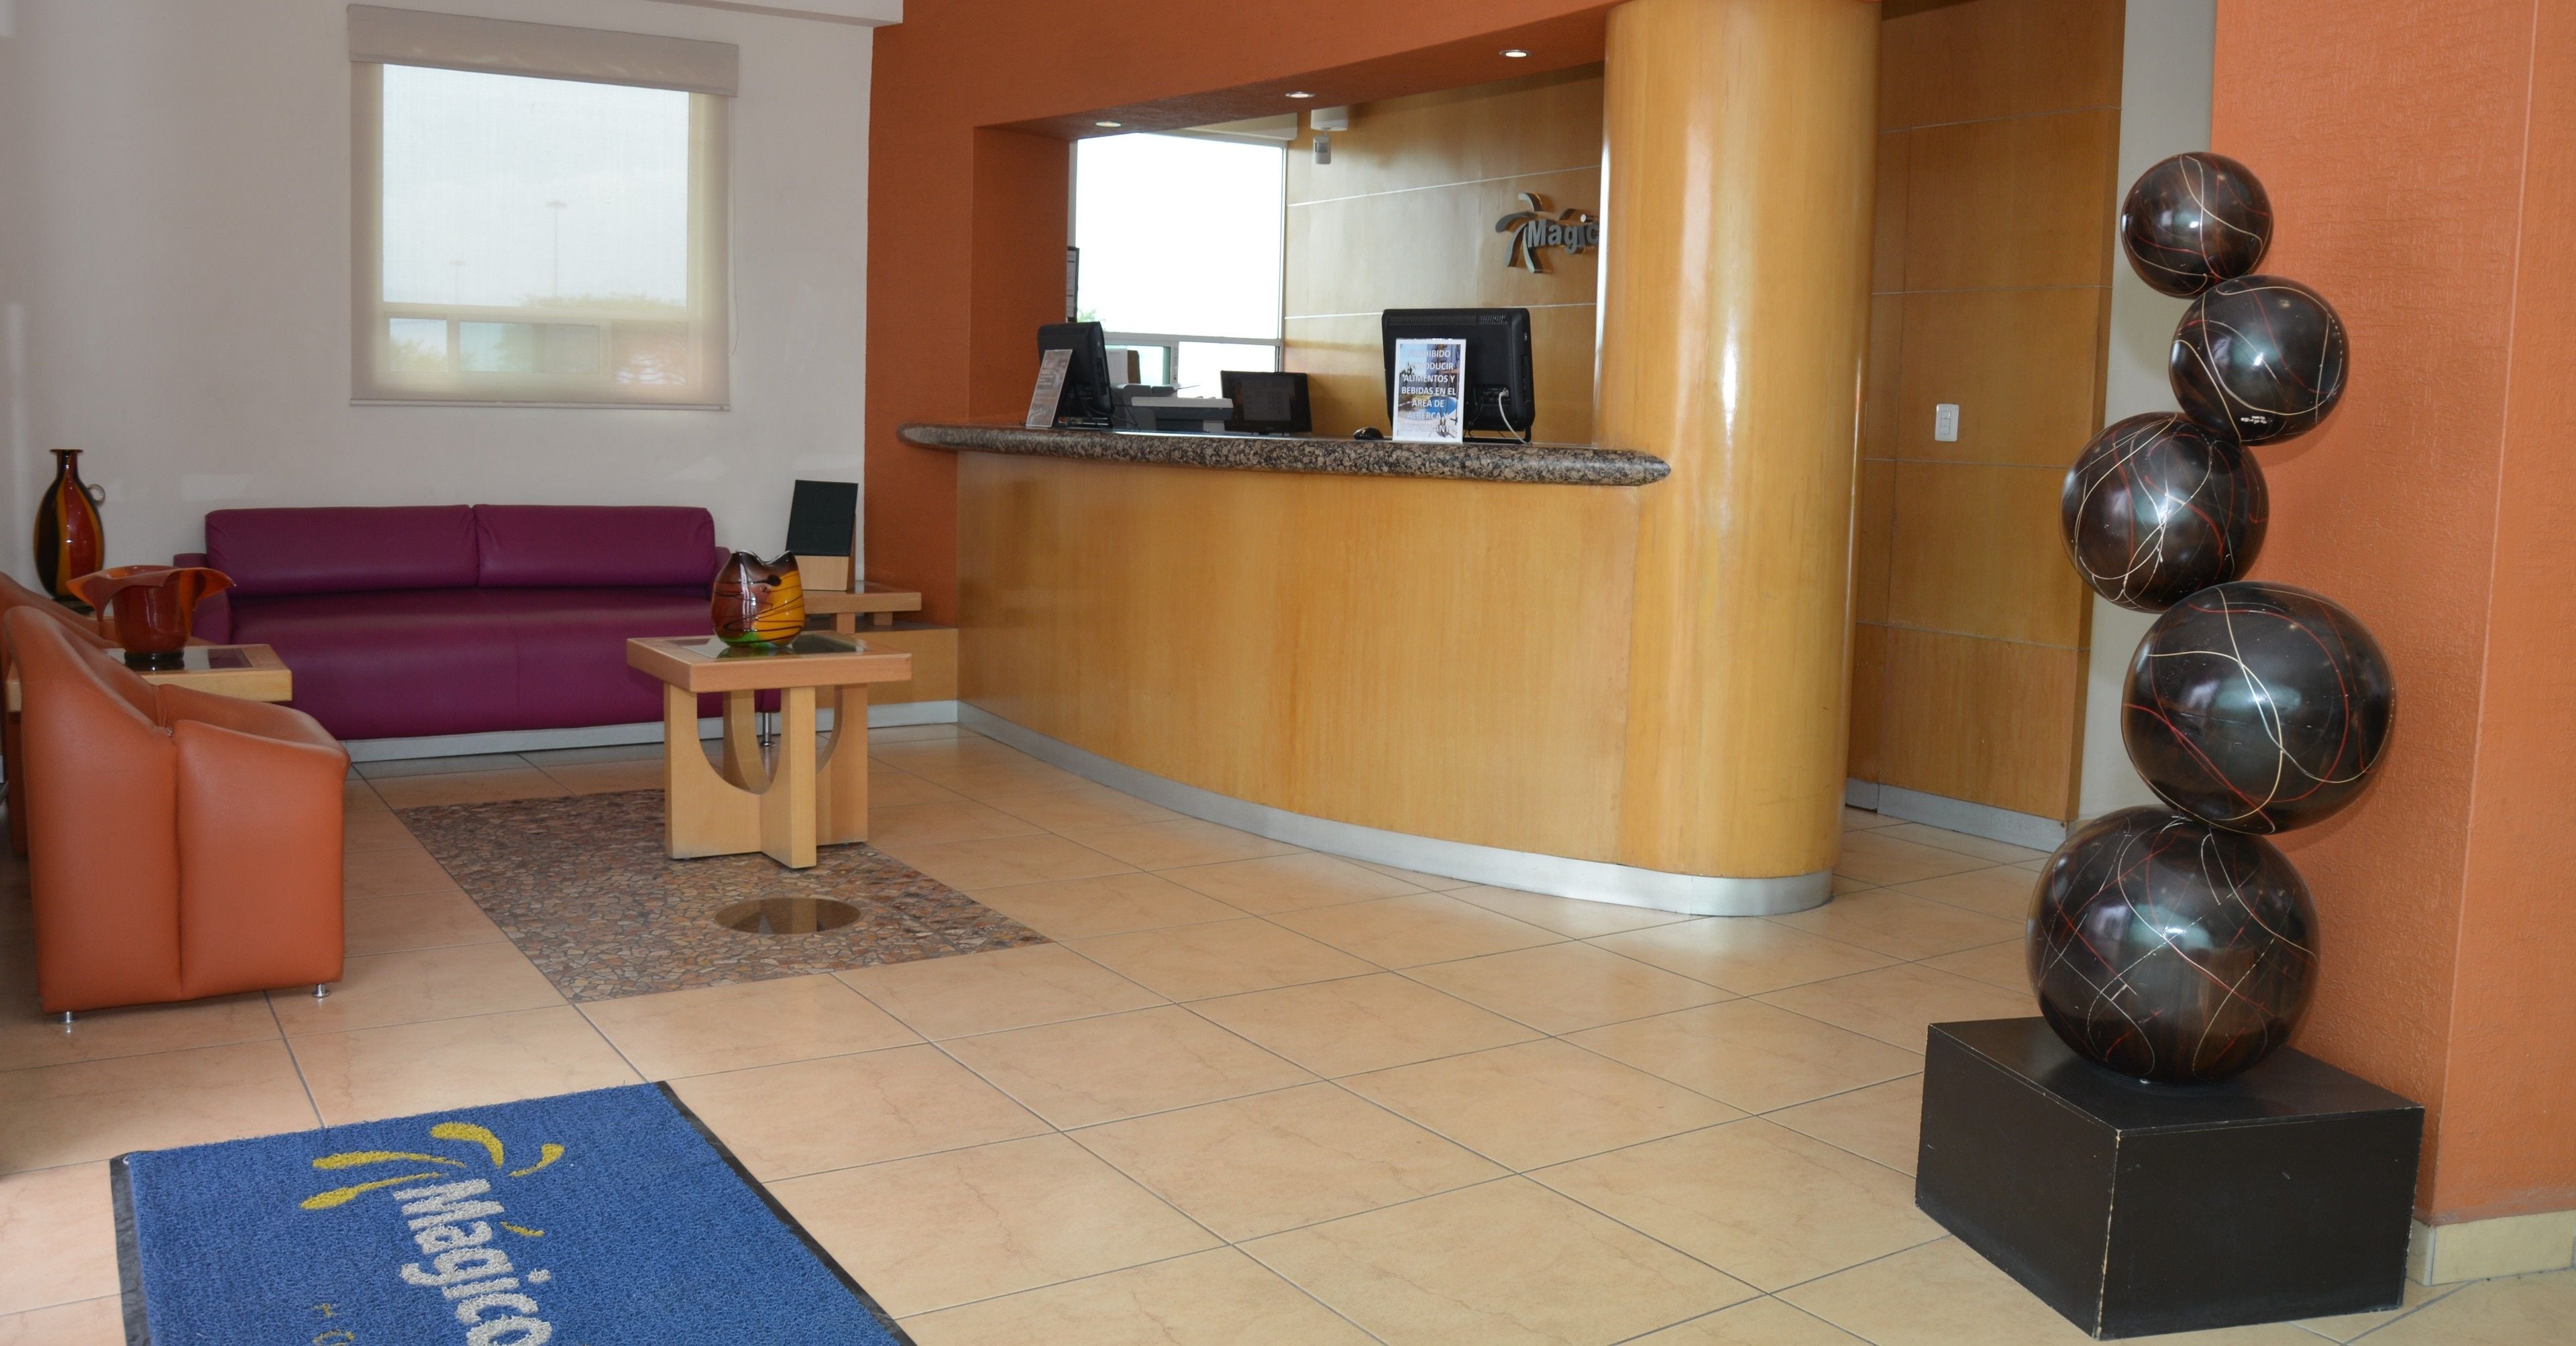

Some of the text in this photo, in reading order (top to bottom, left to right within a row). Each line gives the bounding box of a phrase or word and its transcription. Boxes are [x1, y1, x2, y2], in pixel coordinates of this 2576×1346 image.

[1407, 349, 1451, 357] HIBIDO
[1407, 362, 1454, 370] NODUCIR
[1450, 375, 1456, 383] Y
[1436, 387, 1446, 395] EN
